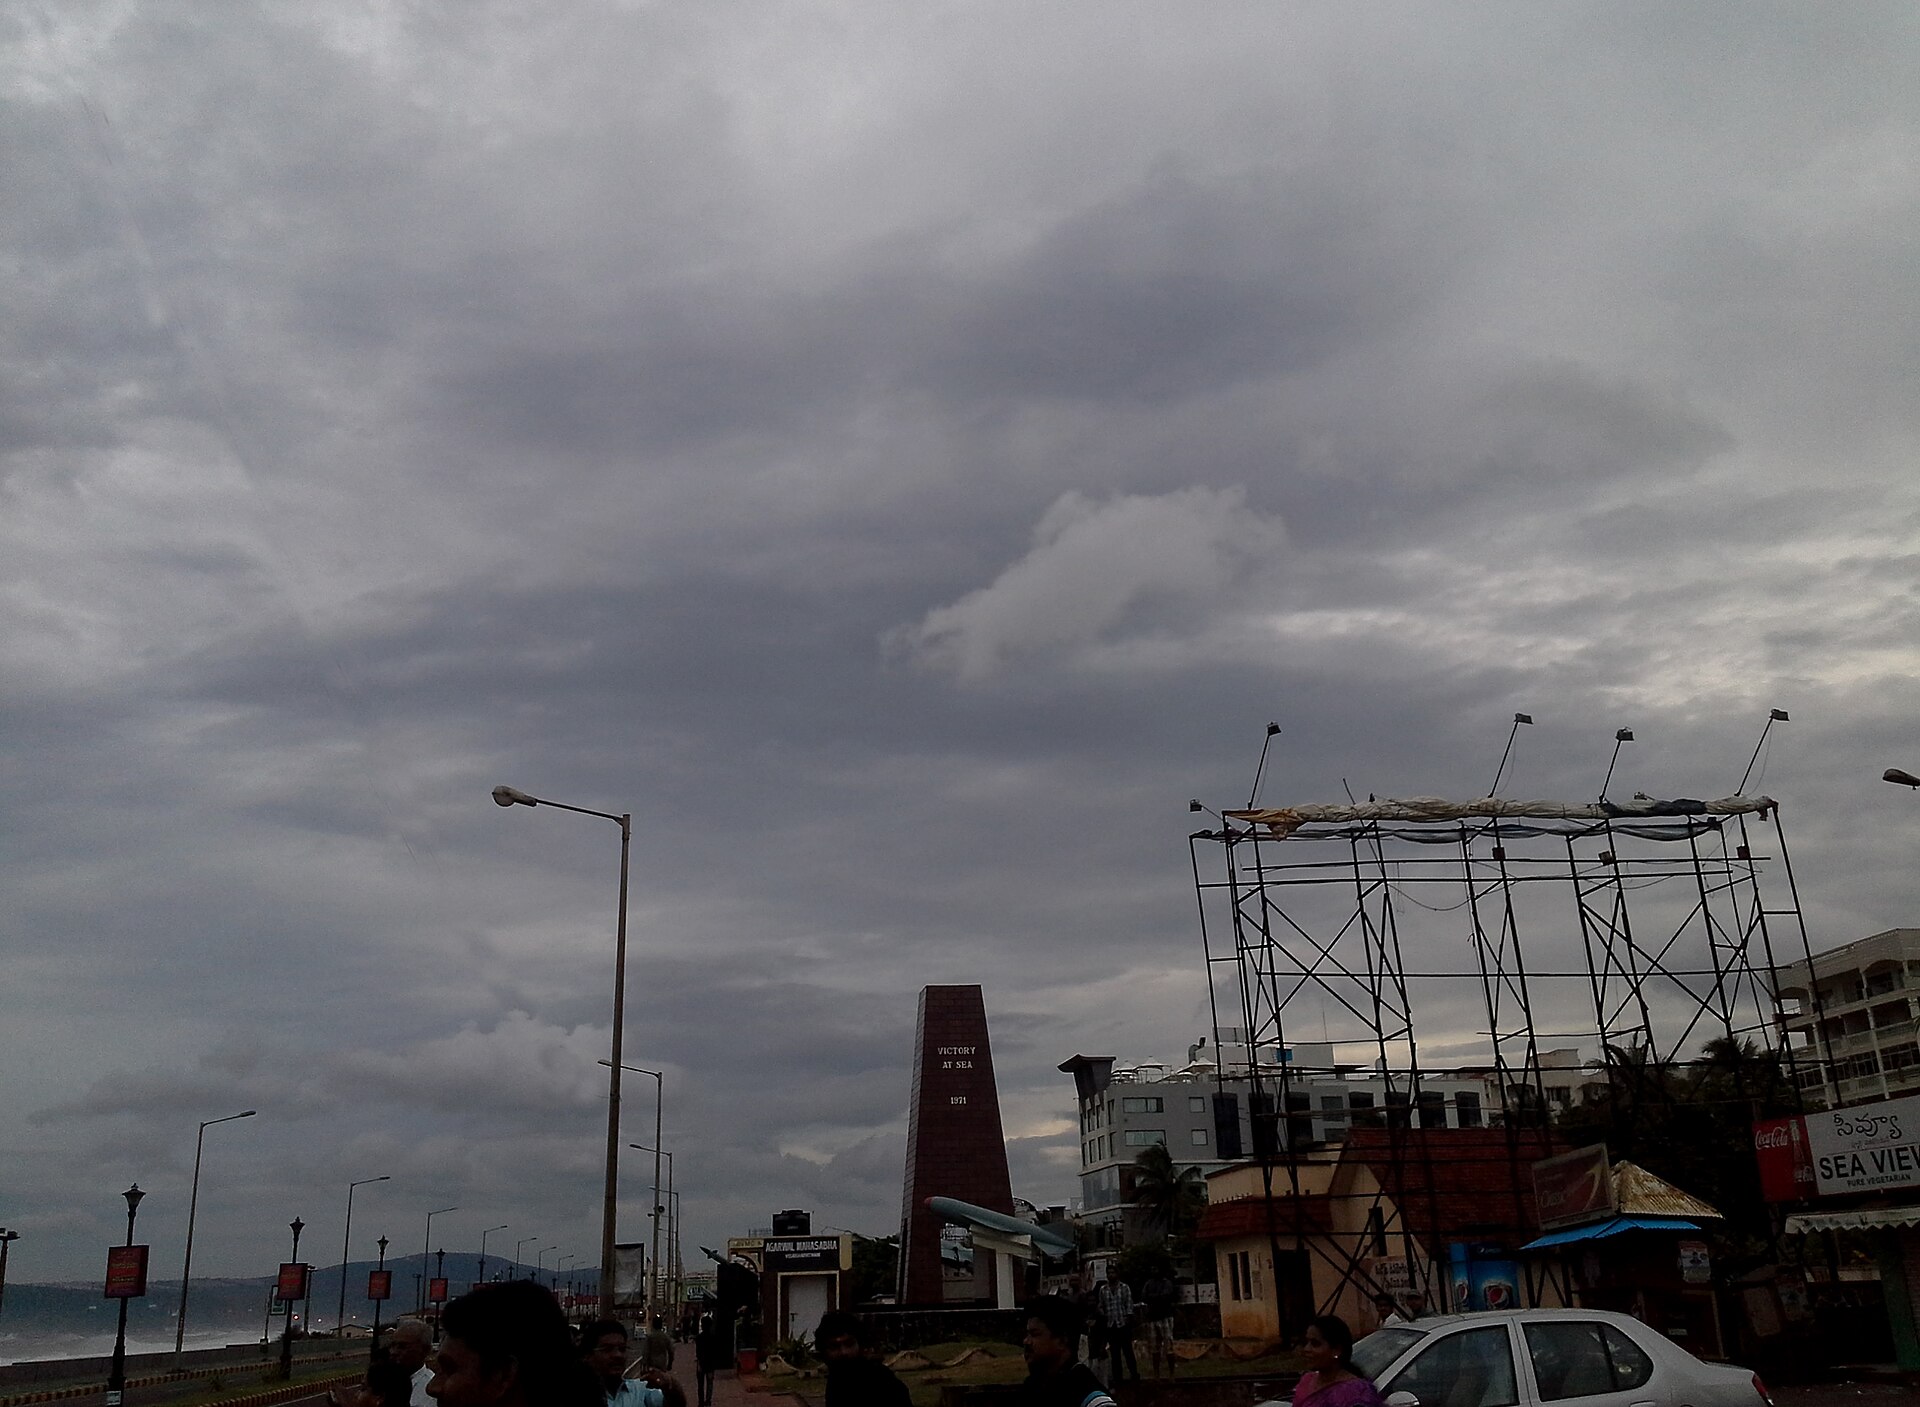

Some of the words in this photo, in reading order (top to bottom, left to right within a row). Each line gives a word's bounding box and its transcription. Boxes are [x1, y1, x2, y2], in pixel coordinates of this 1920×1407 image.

[937, 1046, 976, 1055] VICTORY
[942, 1060, 953, 1069] AT
[955, 1060, 973, 1069] SEA
[950, 1096, 967, 1105] 1971
[1819, 1153, 1867, 1180] SEA
[1847, 1178, 1866, 1187] PURE
[1867, 1174, 1911, 1186] VEGETARIAN
